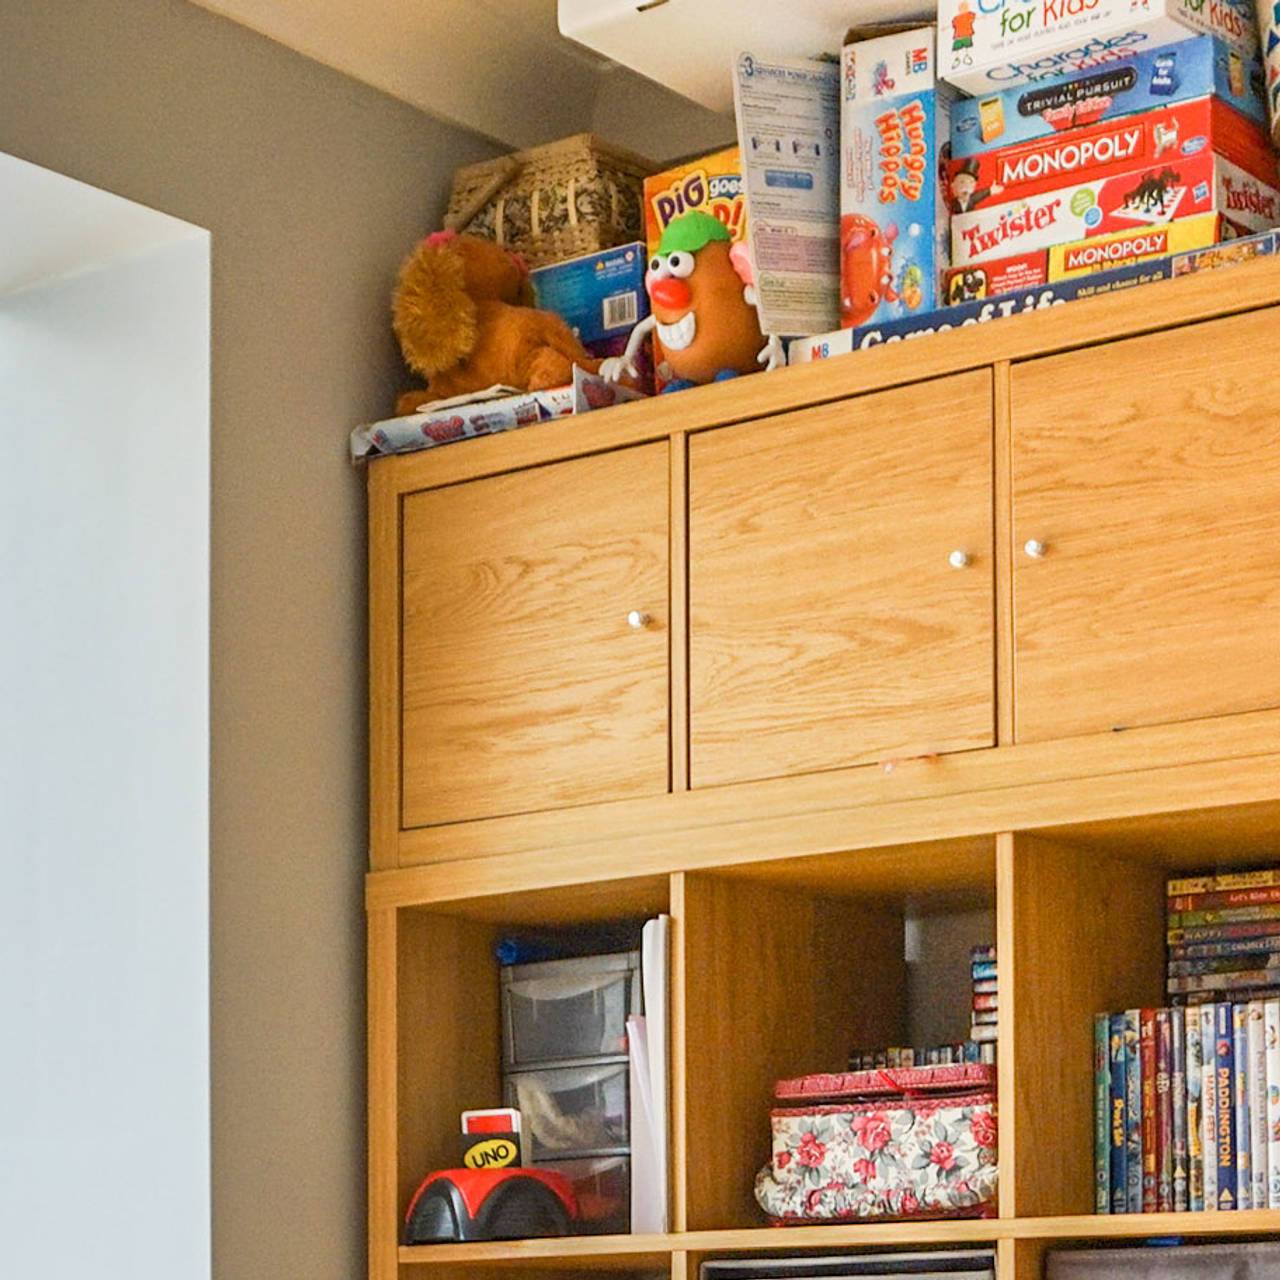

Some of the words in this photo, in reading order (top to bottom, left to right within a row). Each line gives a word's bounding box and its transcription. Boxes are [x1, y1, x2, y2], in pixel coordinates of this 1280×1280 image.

[1000, 7, 1036, 37] for
[912, 47, 928, 74] MB
[986, 30, 1148, 81] Charades
[1026, 93, 1073, 112] TRIVIAL
[1077, 76, 1132, 99] PURSUIT
[875, 111, 901, 203] Hippos
[899, 100, 926, 201] Hungry
[1003, 130, 1139, 183] MONOPOLY
[1222, 175, 1275, 220] Twister
[962, 199, 1061, 258] Twister
[1069, 234, 1165, 267] MONOPOLY
[811, 343, 830, 360] MB
[1218, 1067, 1232, 1167] PADDINGTON
[472, 1145, 509, 1168] UNO
